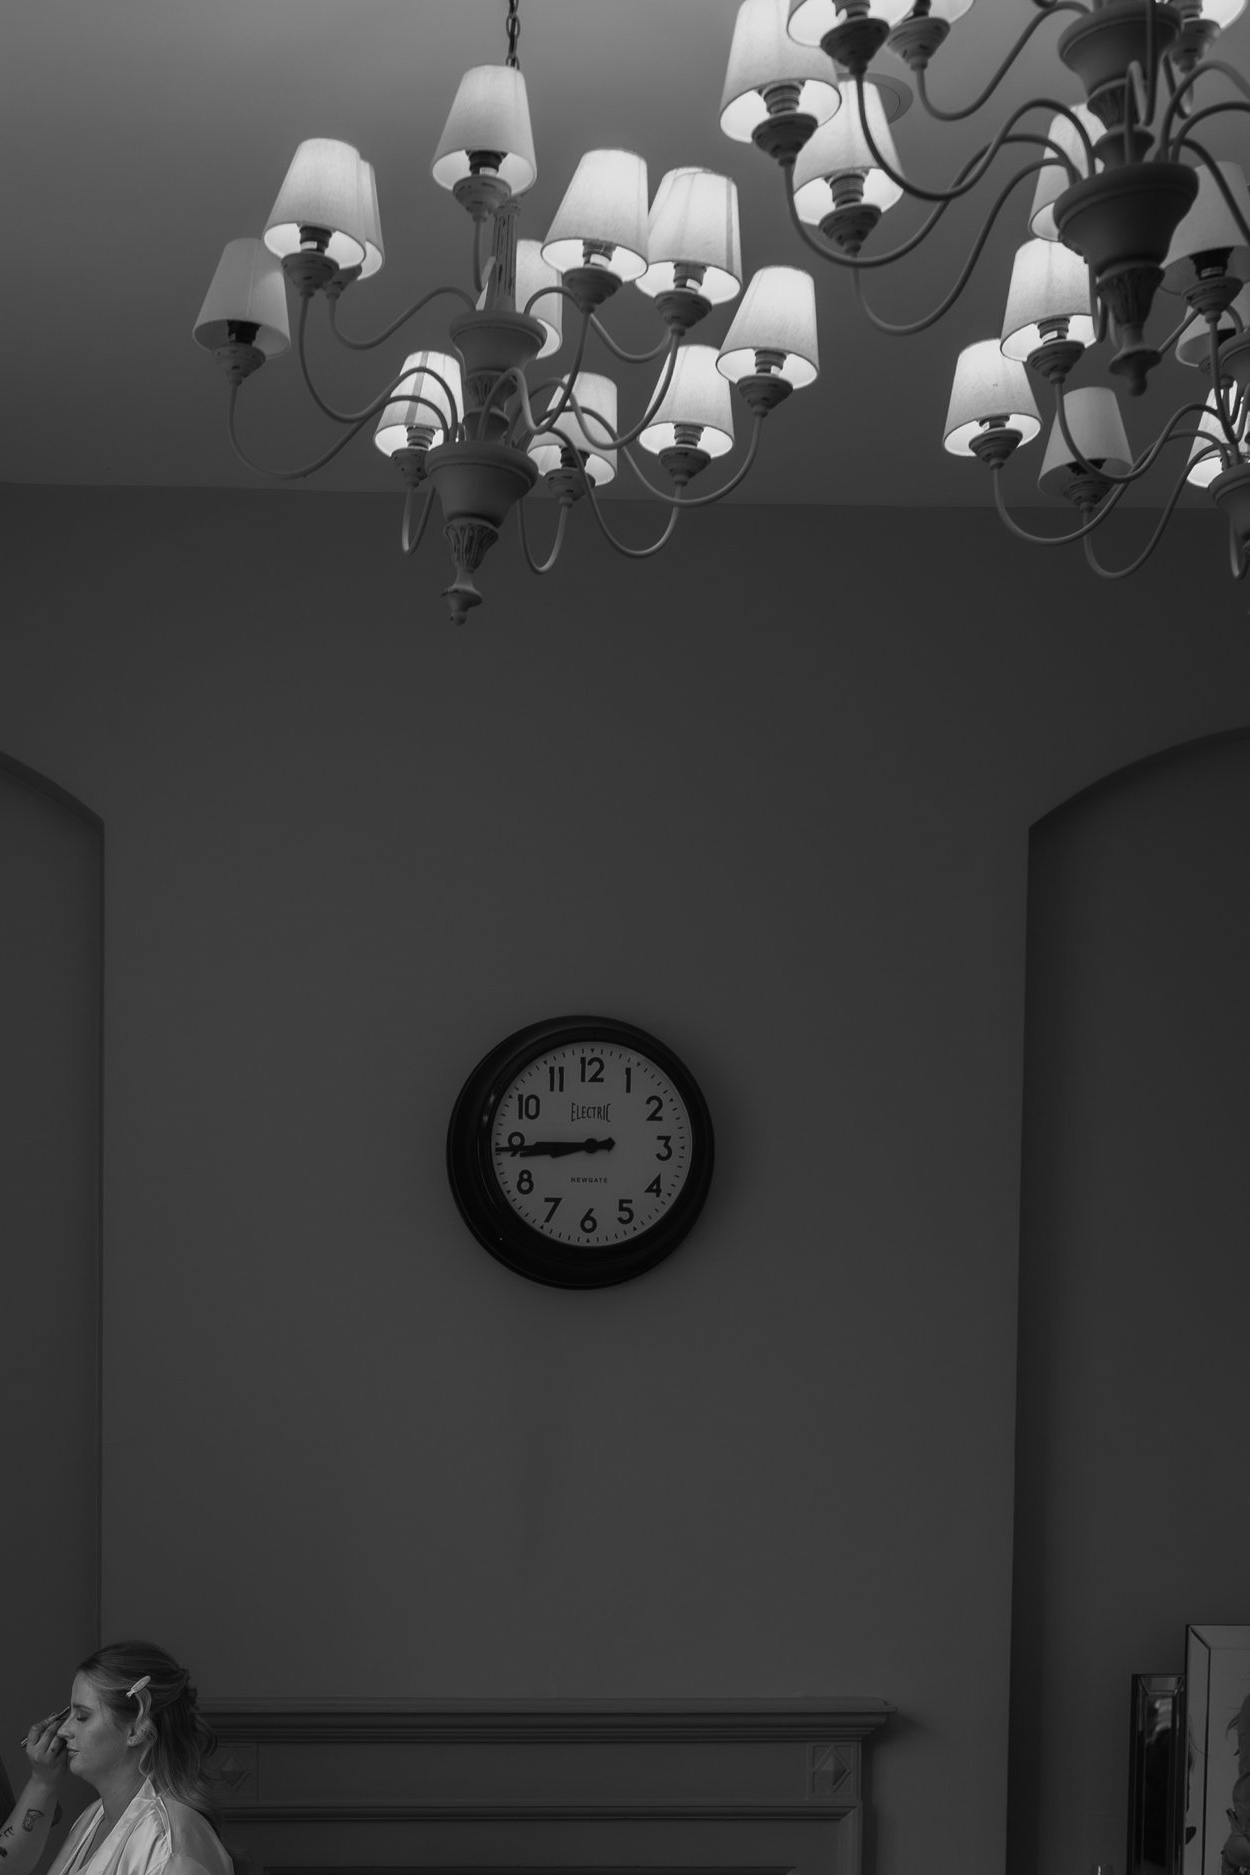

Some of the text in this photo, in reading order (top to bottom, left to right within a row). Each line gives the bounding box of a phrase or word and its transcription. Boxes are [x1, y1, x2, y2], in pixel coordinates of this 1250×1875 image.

[549, 1066, 565, 1092] 11
[581, 1057, 604, 1082] 12
[625, 1067, 632, 1093] 1
[518, 1094, 540, 1120] 10
[571, 1102, 611, 1122] ELECTRIC
[646, 1095, 664, 1121] 2
[656, 1135, 672, 1161] 3
[516, 1169, 534, 1195] 8
[644, 1173, 662, 1197] 4
[544, 1197, 562, 1223] 7
[580, 1208, 597, 1233] 6
[617, 1199, 634, 1224] 5
